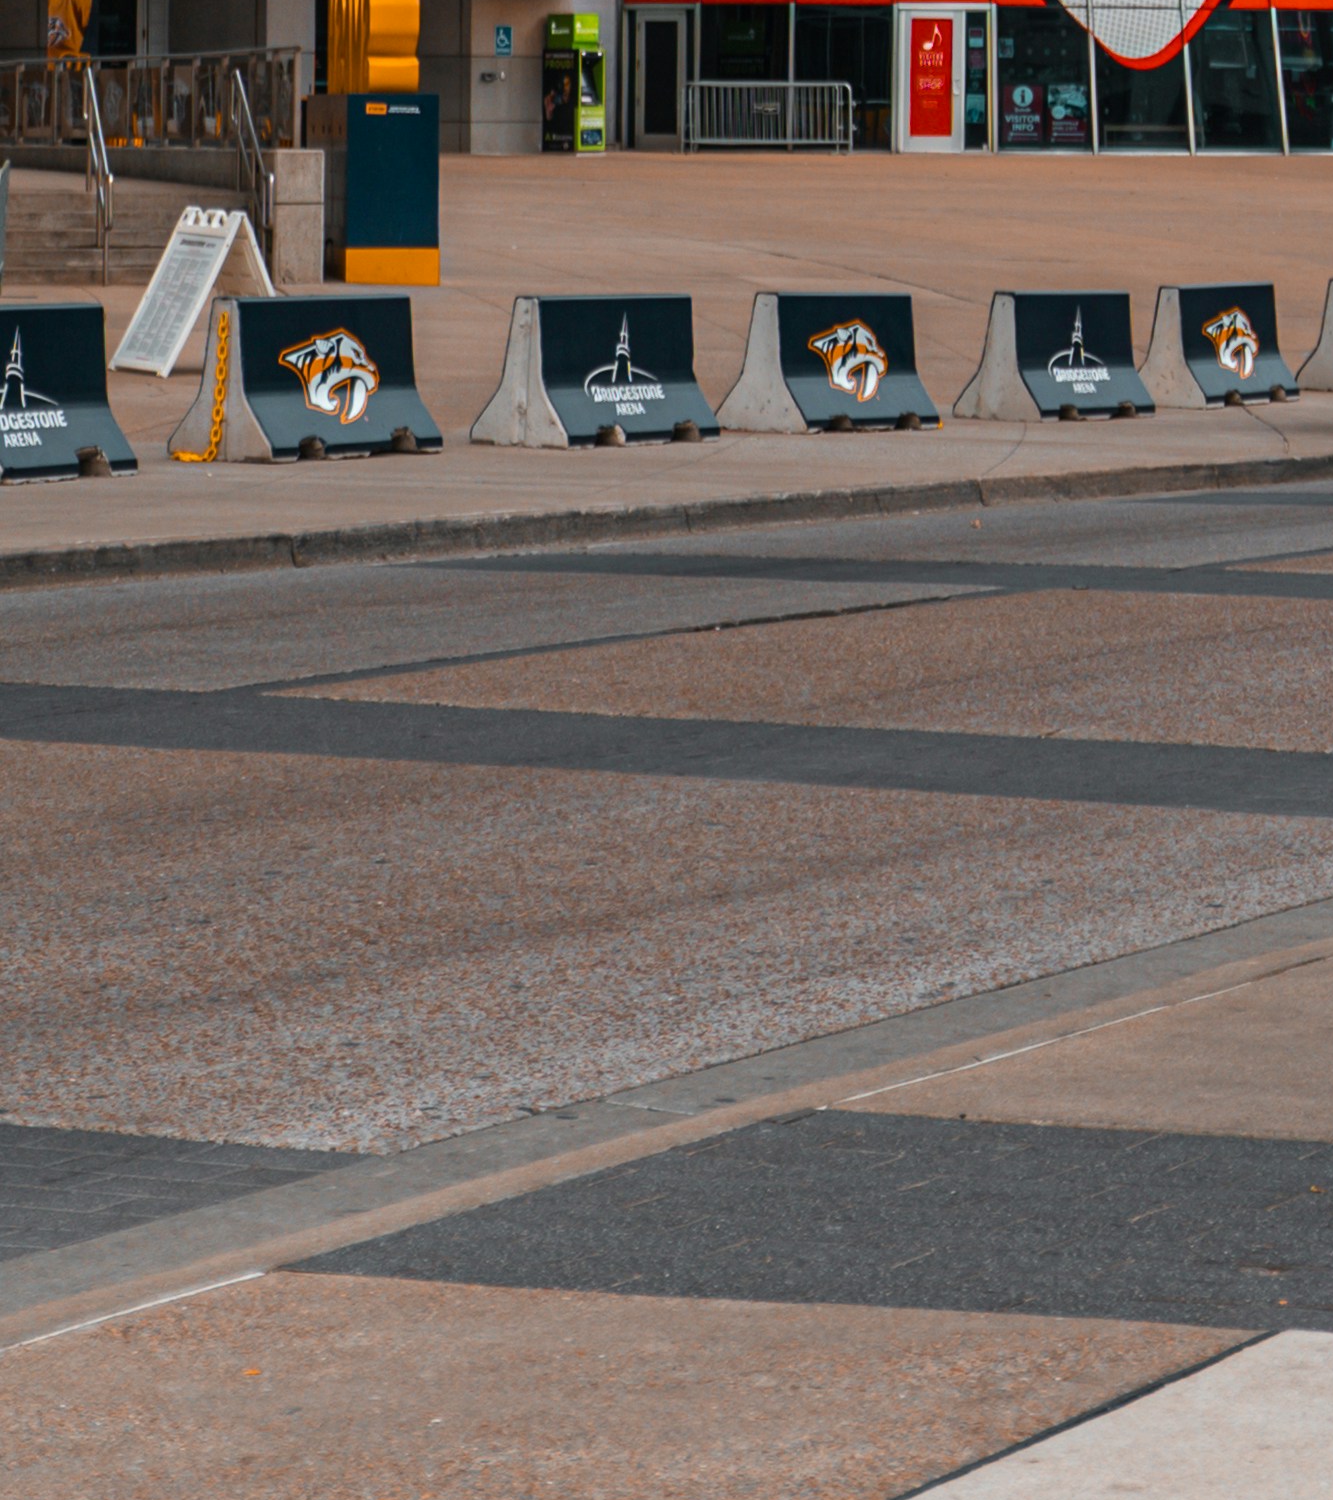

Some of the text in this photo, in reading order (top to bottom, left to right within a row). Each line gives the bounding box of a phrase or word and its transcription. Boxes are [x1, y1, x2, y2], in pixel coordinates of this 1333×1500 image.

[1005, 114, 1040, 123] VISITOR
[1012, 123, 1034, 132] INFO
[591, 384, 665, 402] BRIDGESTONE
[615, 401, 646, 416] ARENA
[3, 431, 42, 448] ARENA
